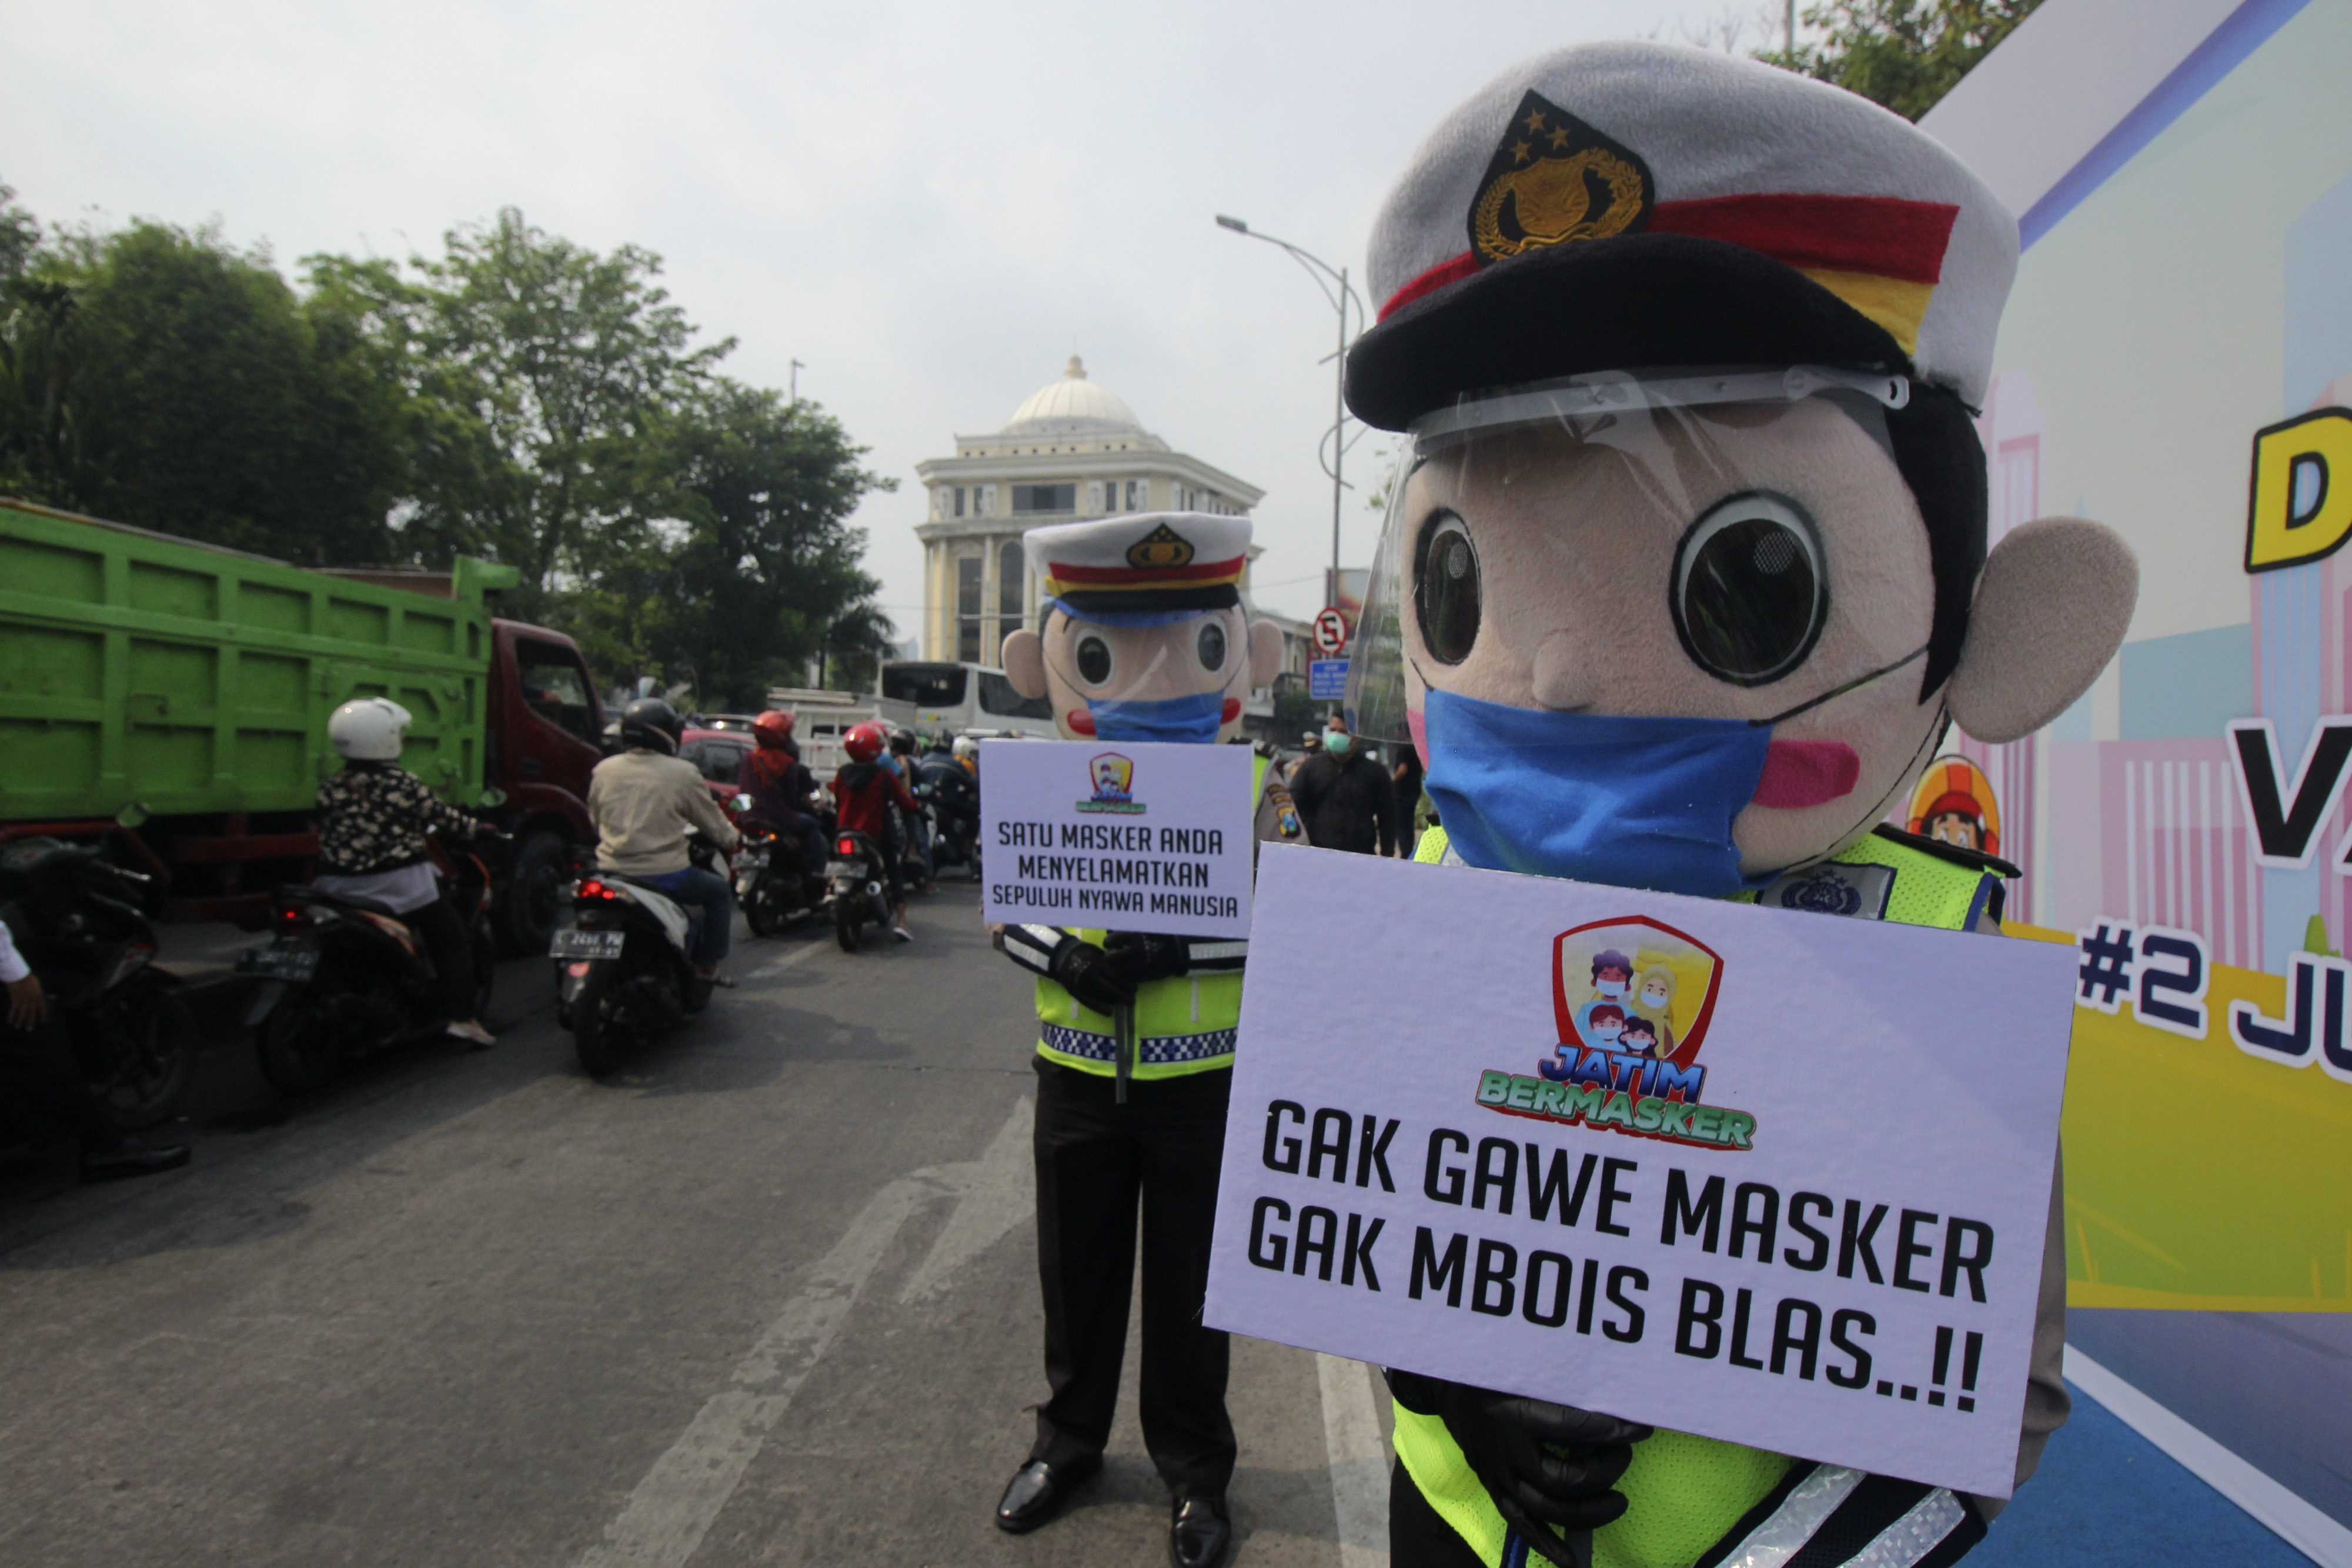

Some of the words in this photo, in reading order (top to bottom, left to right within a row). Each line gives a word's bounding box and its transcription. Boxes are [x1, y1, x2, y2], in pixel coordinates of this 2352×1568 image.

[998, 822, 1053, 847] SATU
[1061, 824, 1151, 851] MASKER
[1160, 828, 1222, 855] ANDA
[1018, 855, 1208, 888] MENYELAMATKAN
[993, 884, 1072, 908] SEPULUH
[1079, 889, 1144, 912] NYAWA
[1151, 893, 1238, 918] MANUSIA
[2079, 923, 2202, 1030] #2
[1540, 1045, 1705, 1104] JATIM
[1476, 1070, 1755, 1149] BERMASKER
[1262, 1099, 1401, 1193] GAK
[1424, 1128, 1638, 1237] GAWE
[1660, 1168, 1994, 1303] MASKER
[1248, 1196, 1386, 1292] GAK
[1408, 1226, 1649, 1343] MBOIS
[1675, 1278, 1983, 1413] BLAS..!!
